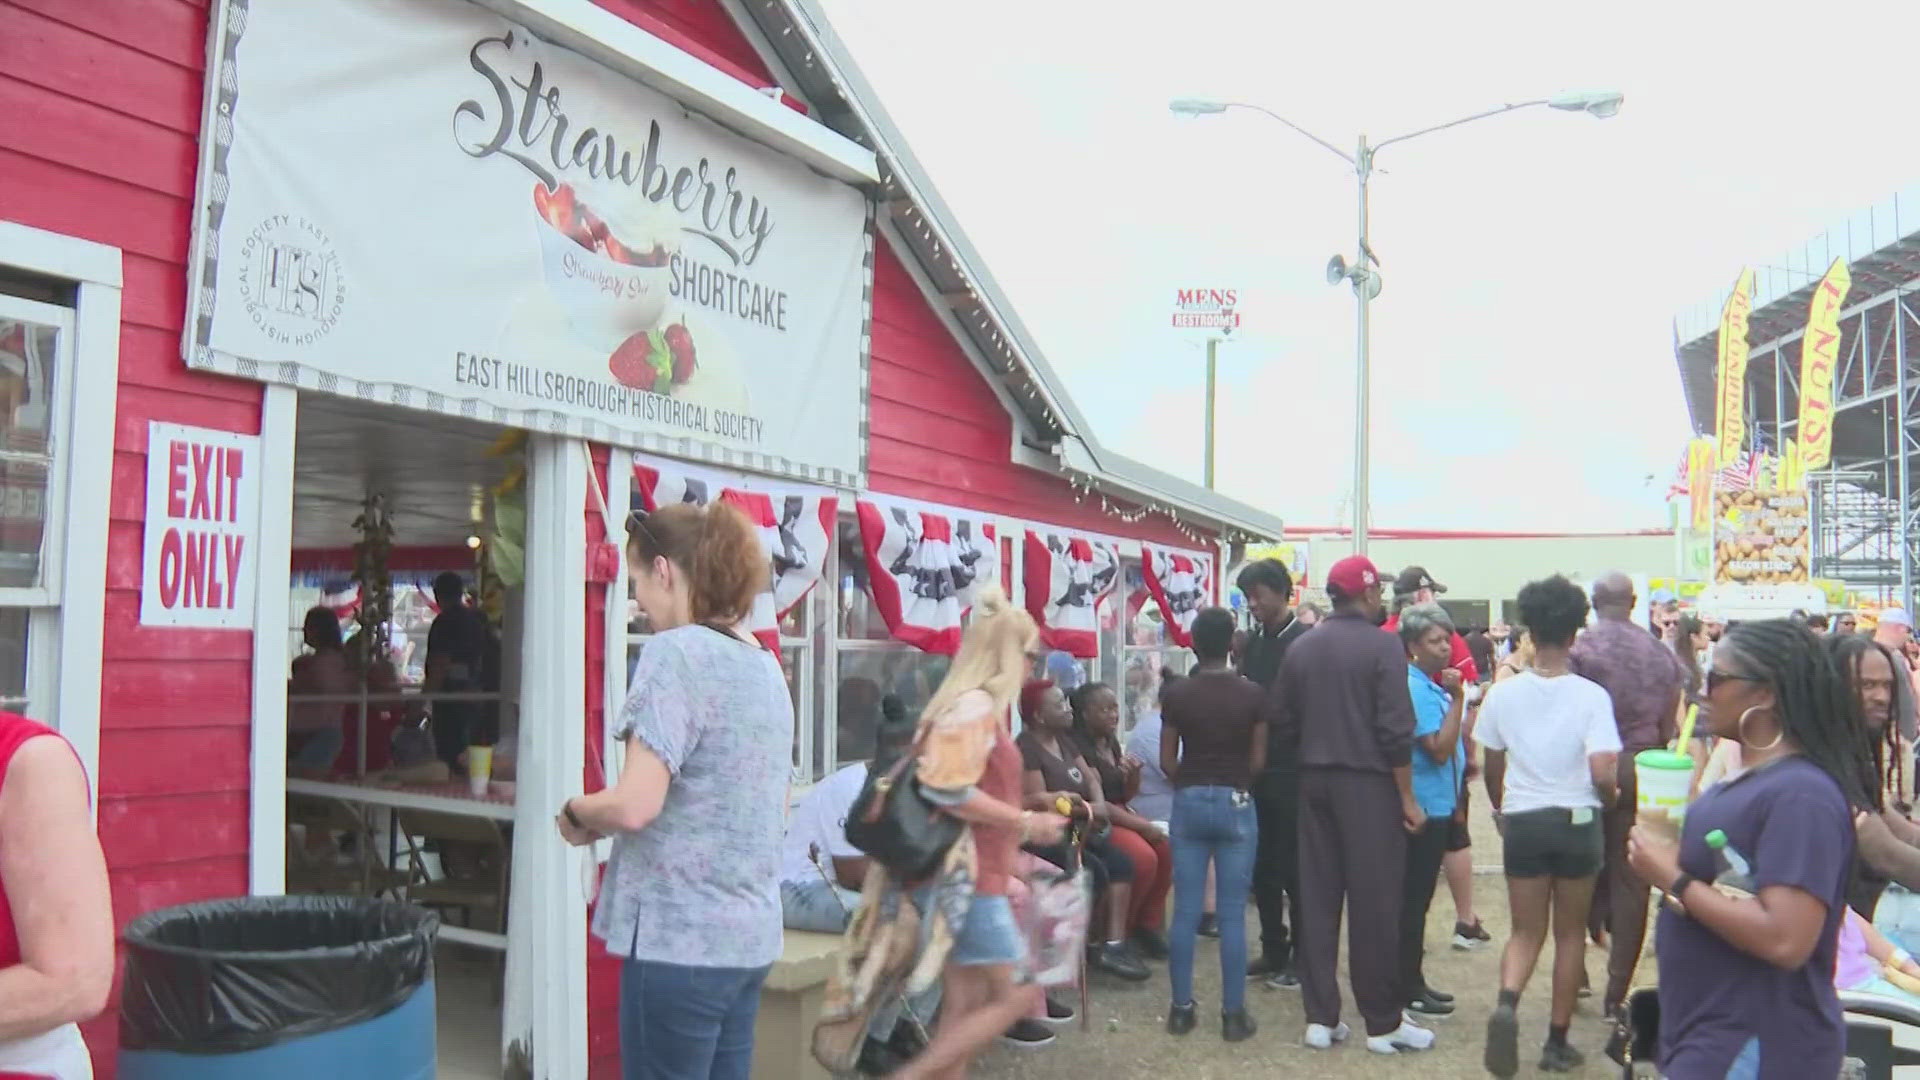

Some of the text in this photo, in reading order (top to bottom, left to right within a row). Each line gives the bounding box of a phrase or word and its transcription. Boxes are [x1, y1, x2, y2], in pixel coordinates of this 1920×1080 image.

[453, 30, 775, 266] Strawberry
[241, 214, 289, 259] SOCIETY
[300, 217, 330, 246] EAST
[239, 265, 290, 344] HISTORICAL
[668, 252, 788, 332] SHORTCAKE
[1174, 313, 1236, 327] RESTROOMS
[1176, 288, 1237, 306] MENS
[456, 351, 764, 443] EAST HILLSBOROUGH HISTORICAL SOCIETY
[167, 439, 244, 524] EXIT
[159, 526, 245, 611] ONLY
